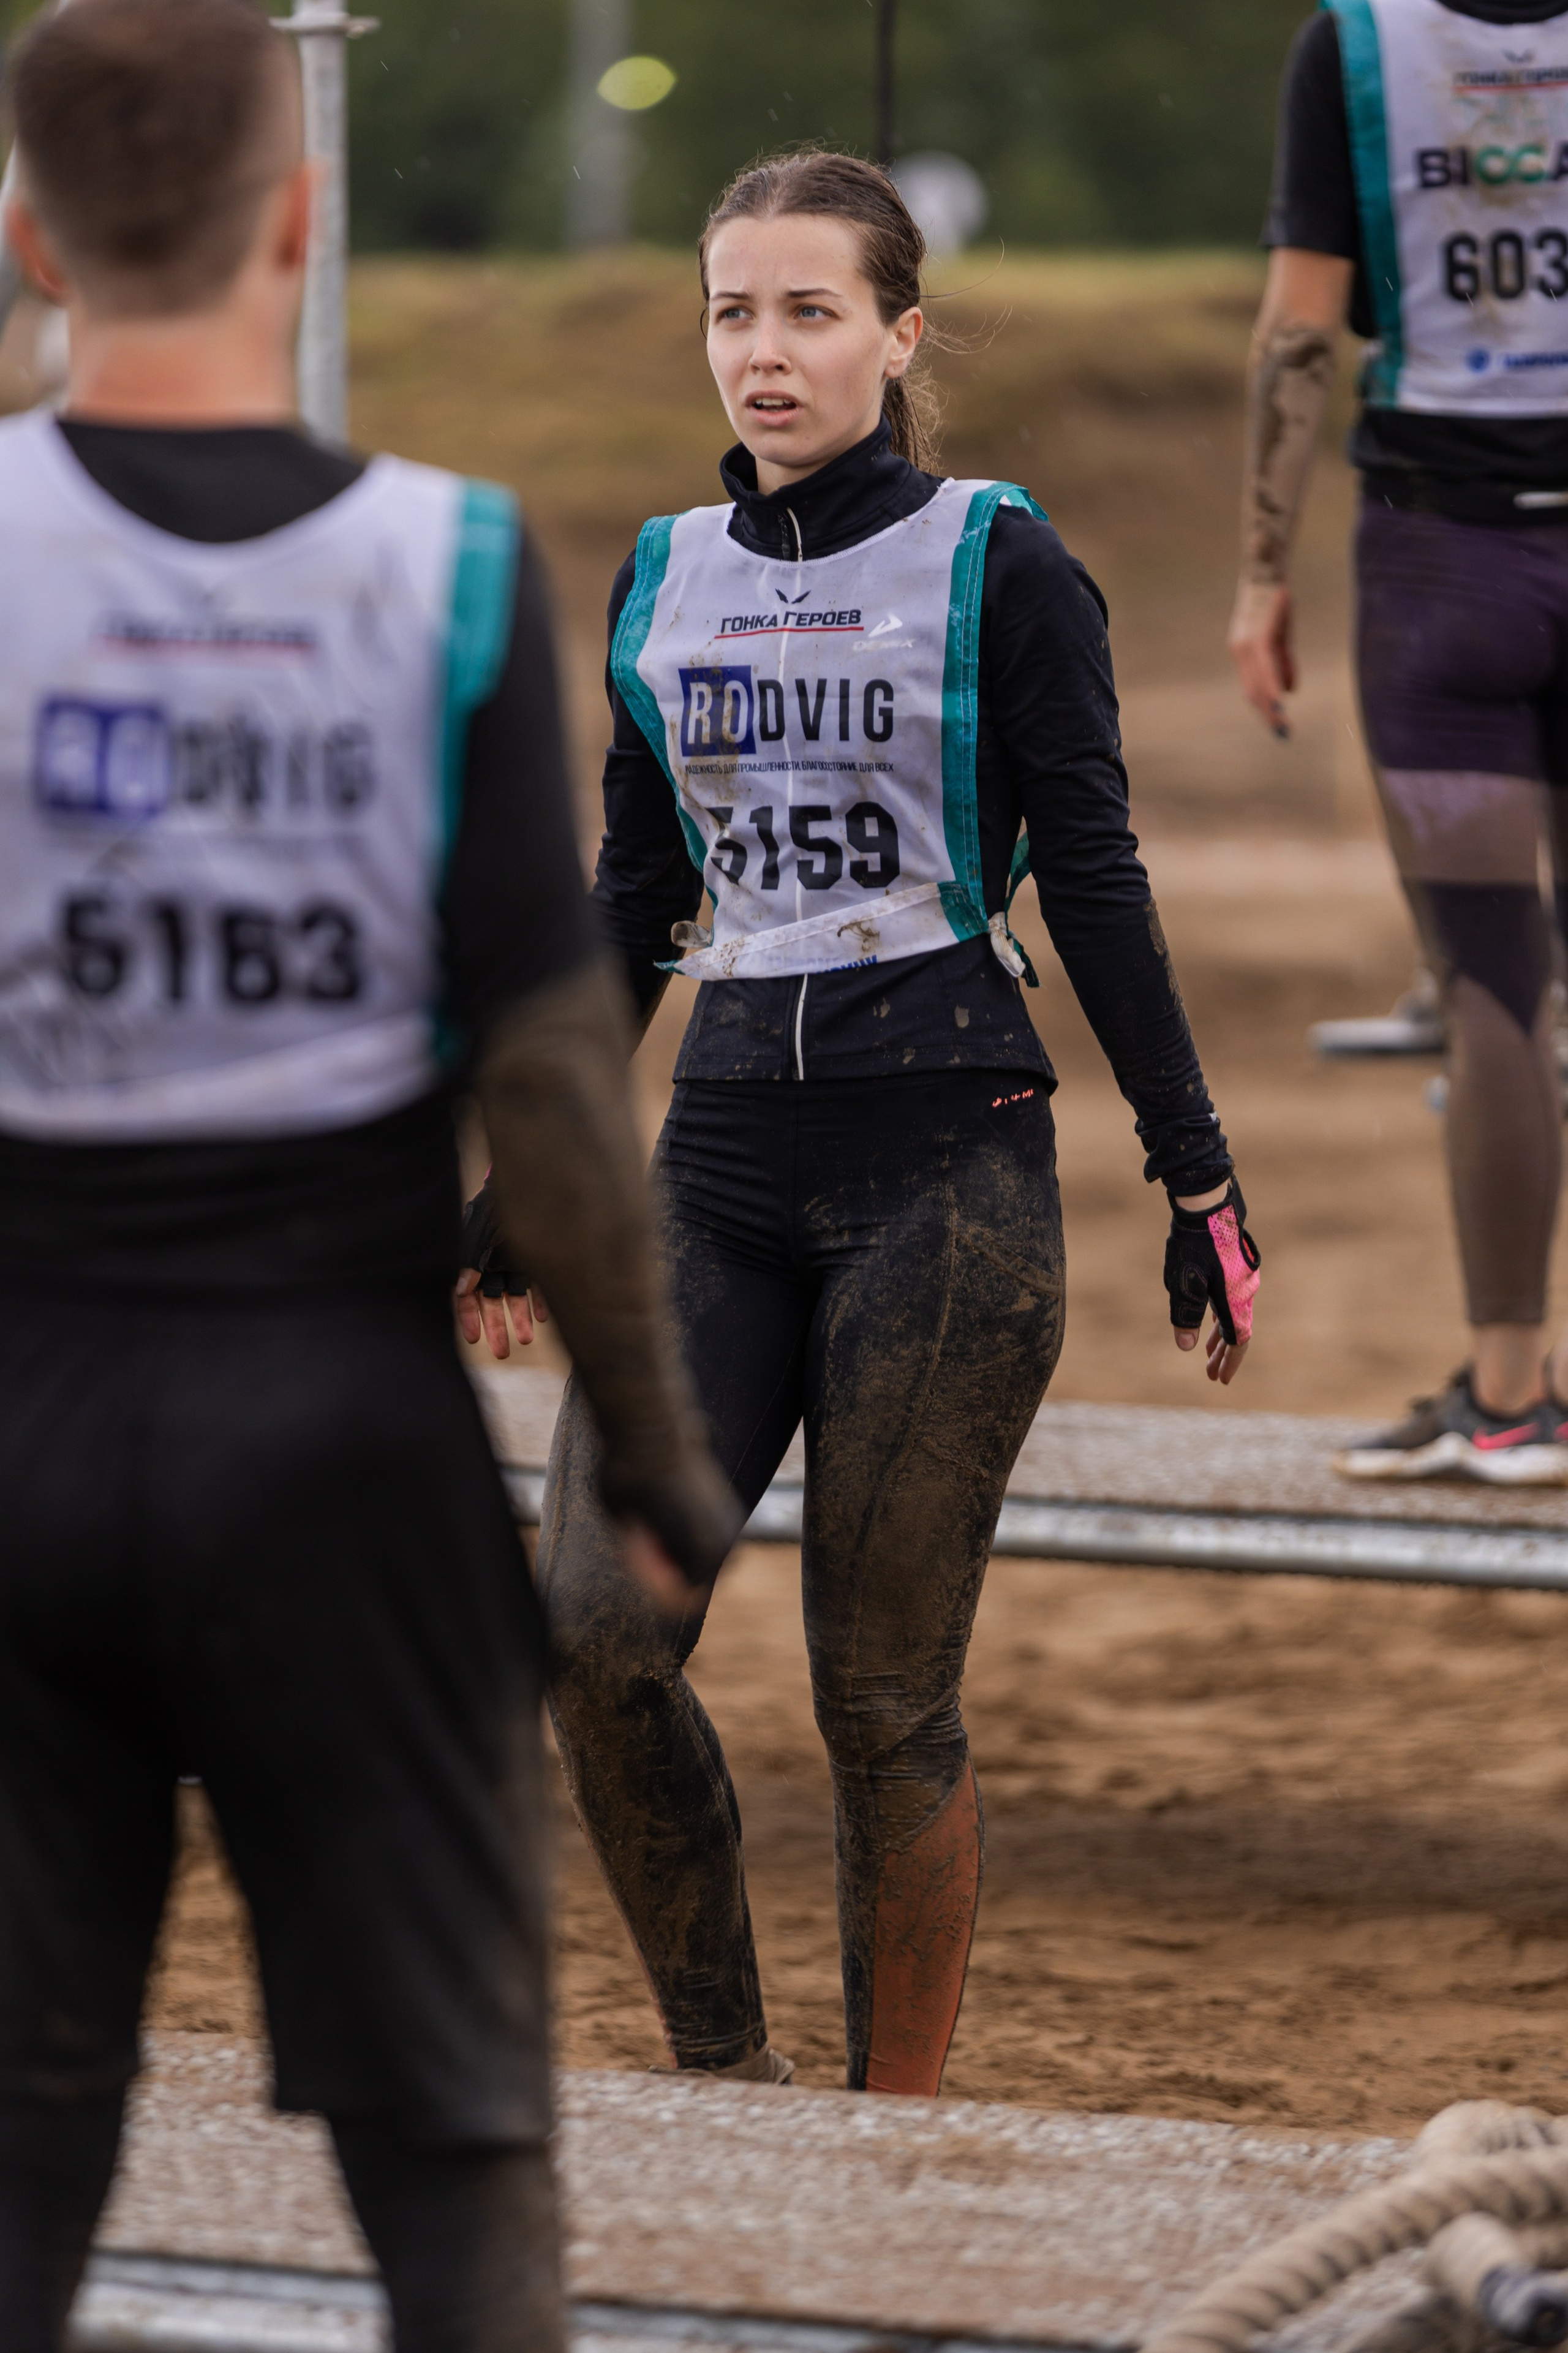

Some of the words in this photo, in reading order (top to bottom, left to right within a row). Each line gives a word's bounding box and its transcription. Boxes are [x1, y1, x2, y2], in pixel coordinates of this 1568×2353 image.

[1443, 227, 1568, 301] 603
[721, 614, 778, 634] ГОНКА
[783, 609, 862, 627] ГЕРОЕВ
[687, 678, 894, 745] RODVIG
[859, 762, 874, 772] ДЛЯ
[875, 762, 894, 772] ВСЕХ
[705, 801, 900, 890] 5159
